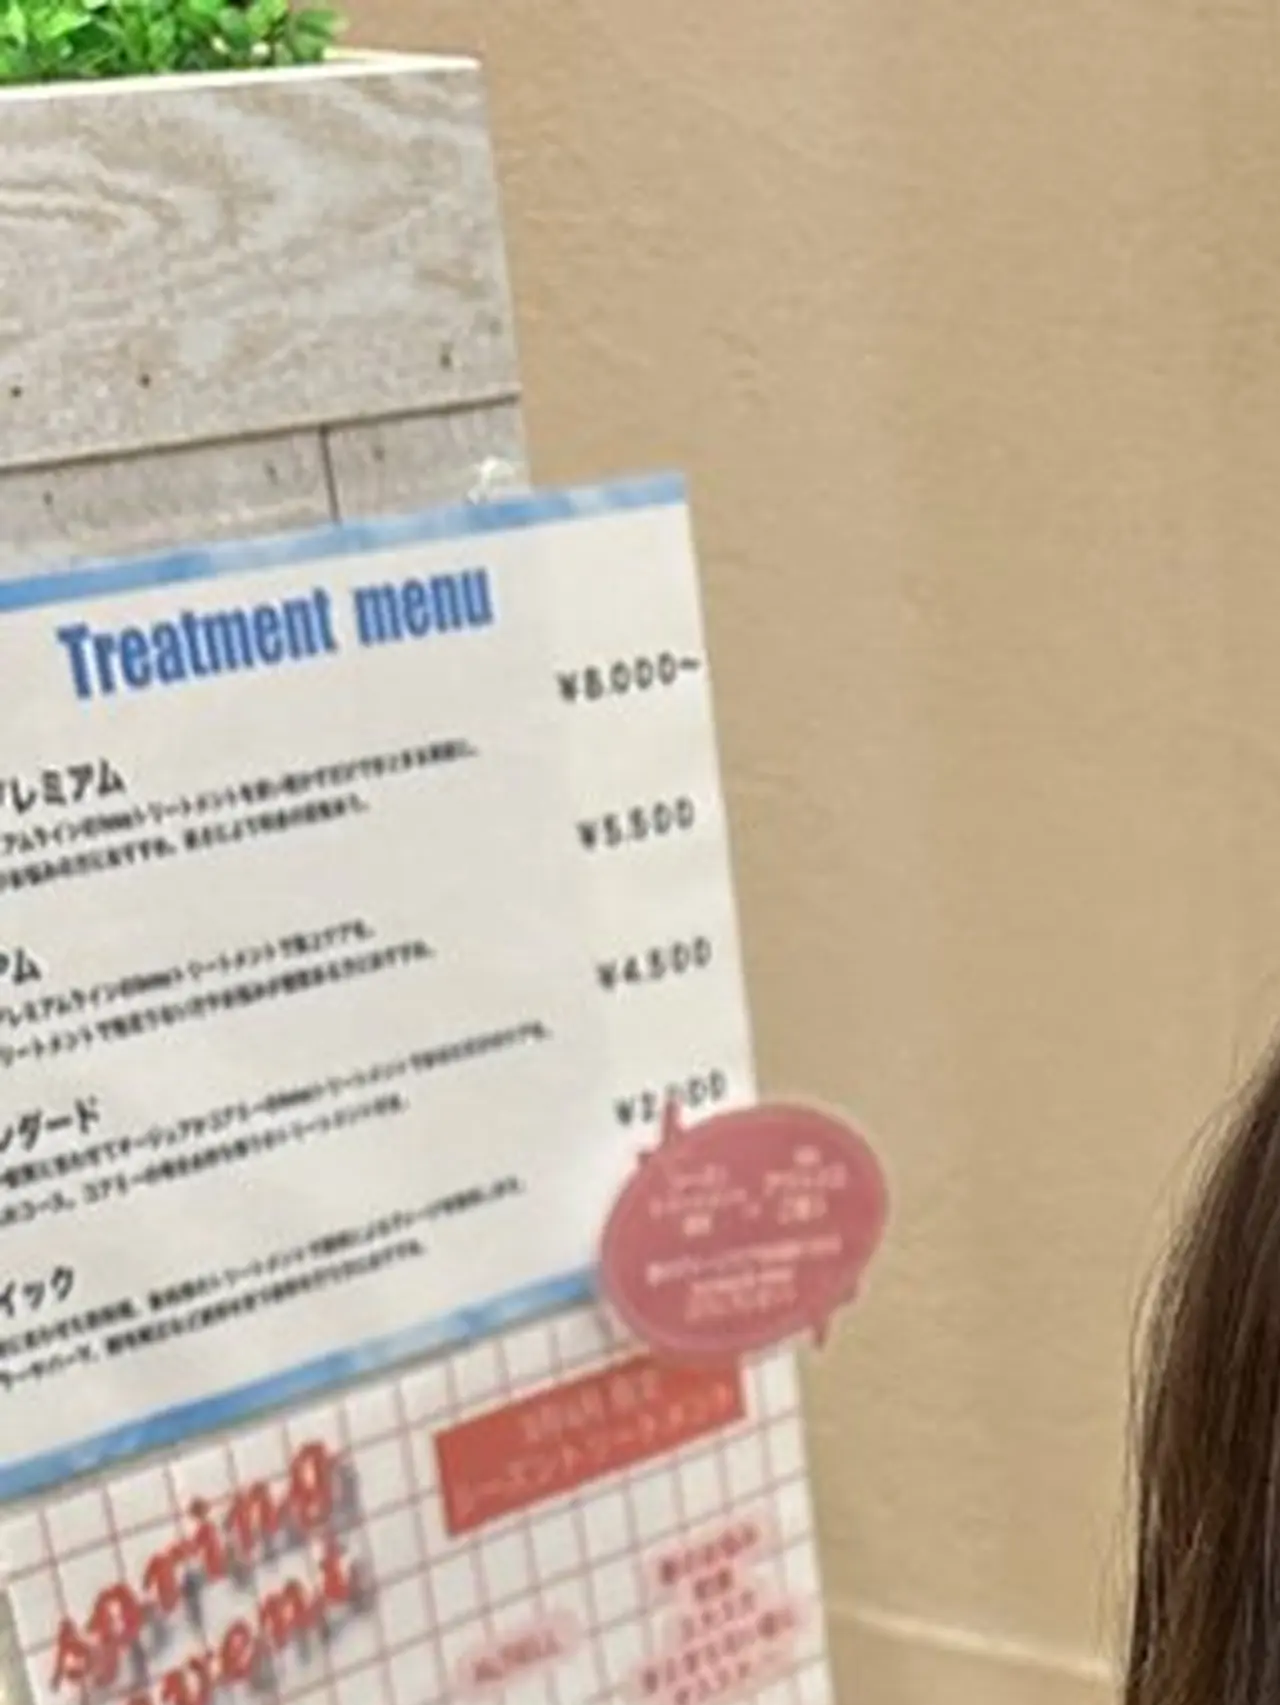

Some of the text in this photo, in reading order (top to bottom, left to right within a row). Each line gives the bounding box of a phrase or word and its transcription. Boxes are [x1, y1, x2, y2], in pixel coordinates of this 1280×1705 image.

[56, 567, 495, 699] Treatment menu
[52, 1441, 333, 1692] spring
